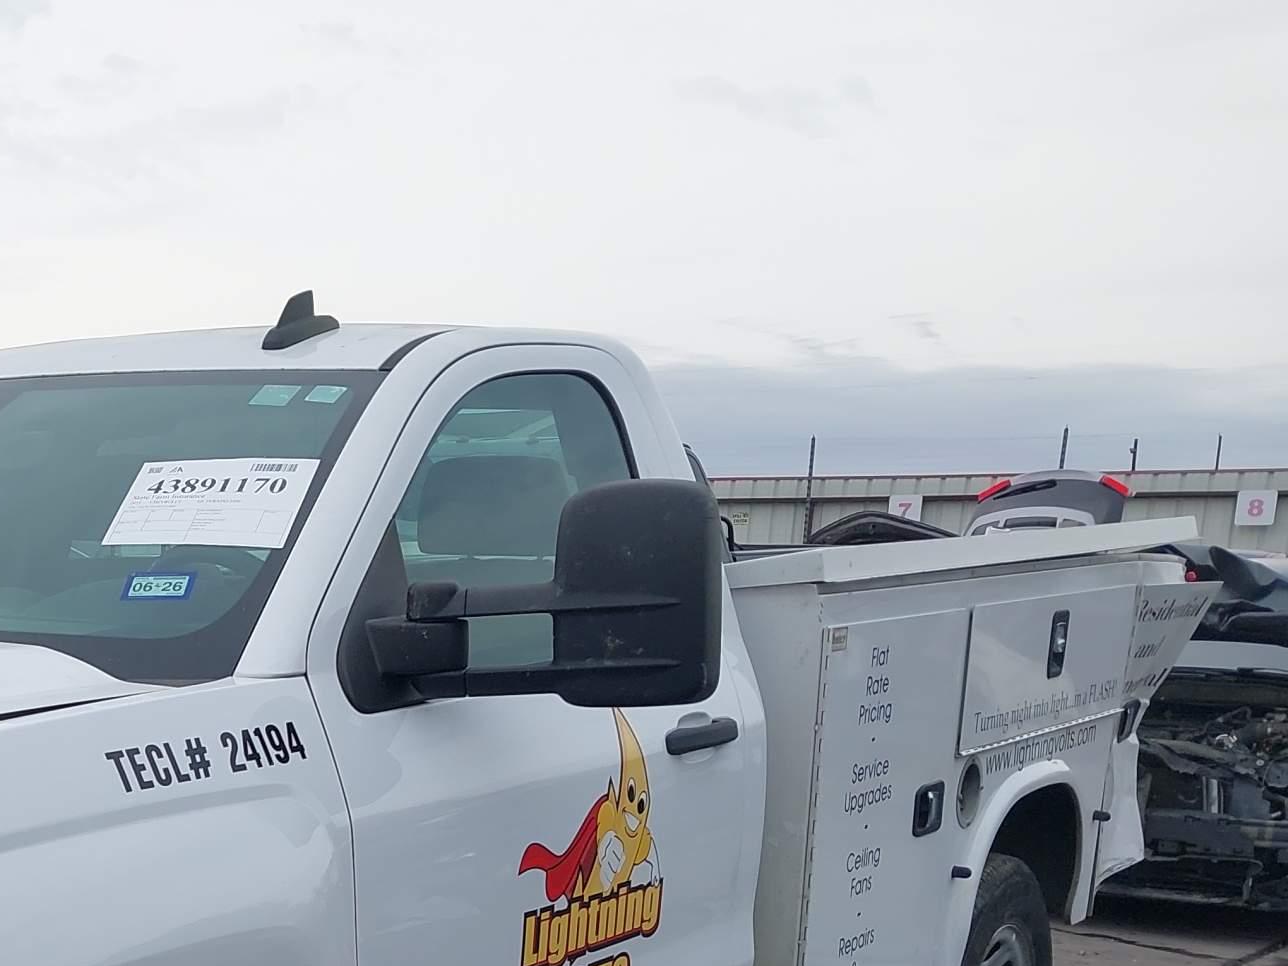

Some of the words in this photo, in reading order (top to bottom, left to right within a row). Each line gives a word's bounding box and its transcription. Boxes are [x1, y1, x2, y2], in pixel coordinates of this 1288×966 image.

[147, 477, 288, 494] 43891170
[898, 503, 912, 517] 7
[1248, 499, 1264, 516] 8
[871, 646, 890, 667] Flat
[866, 676, 890, 696] Rate
[858, 703, 893, 726] Pricing
[974, 704, 1009, 734] Turning
[1011, 700, 1032, 729] night
[104, 737, 212, 793] TECL#
[220, 721, 307, 773] 24194
[985, 724, 1097, 776] www.lightningvolts.com
[852, 759, 890, 784] Service
[844, 783, 893, 816] Upgrades
[846, 847, 881, 873] Ceiling
[850, 875, 872, 899] Fans
[838, 928, 875, 958] Repairs
